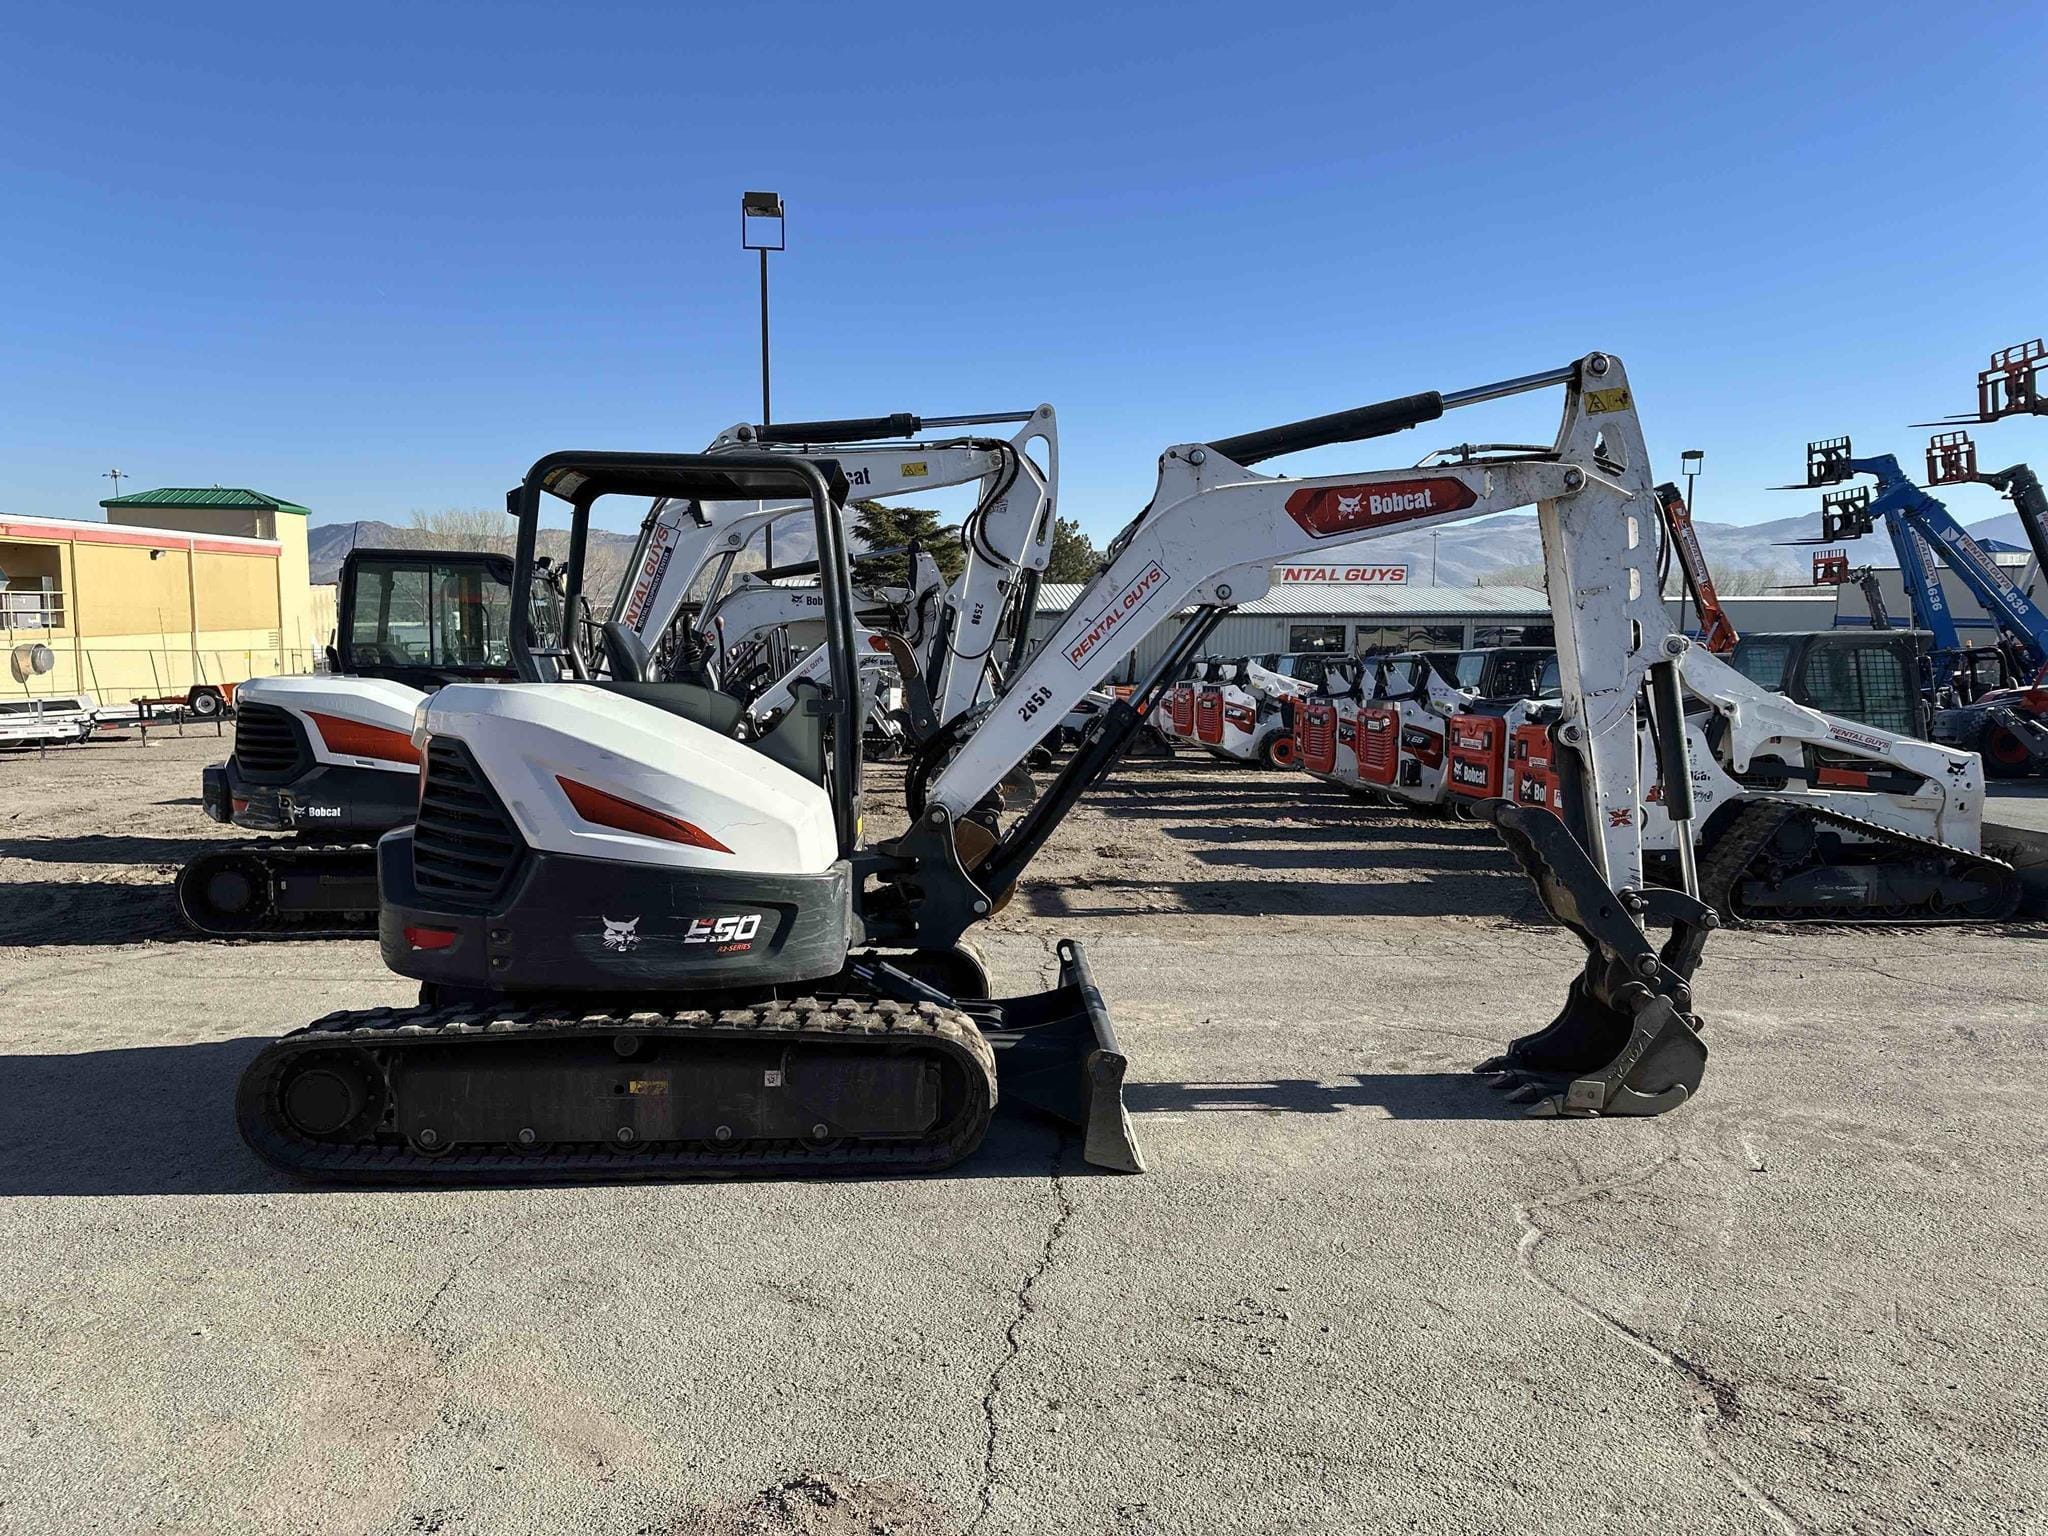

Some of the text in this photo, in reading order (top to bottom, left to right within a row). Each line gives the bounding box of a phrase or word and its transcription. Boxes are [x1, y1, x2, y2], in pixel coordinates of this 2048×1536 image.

[1369, 489, 1432, 515] Bobcat
[1283, 568, 1405, 581] NTAL GUYS
[1962, 537, 1989, 566] RENTAL
[1989, 566, 2013, 590] GUYS
[623, 526, 669, 629] NTAL GUYS
[1928, 587, 1943, 611] 636
[2006, 592, 2029, 615] 636
[1070, 568, 1161, 663] RENTAL GUYS
[1018, 686, 1053, 722] 2658
[1830, 727, 1864, 742] RENTAL
[1865, 737, 1890, 749] GUYS
[1463, 762, 1486, 785] Bobcat
[308, 806, 341, 817] Bobcat
